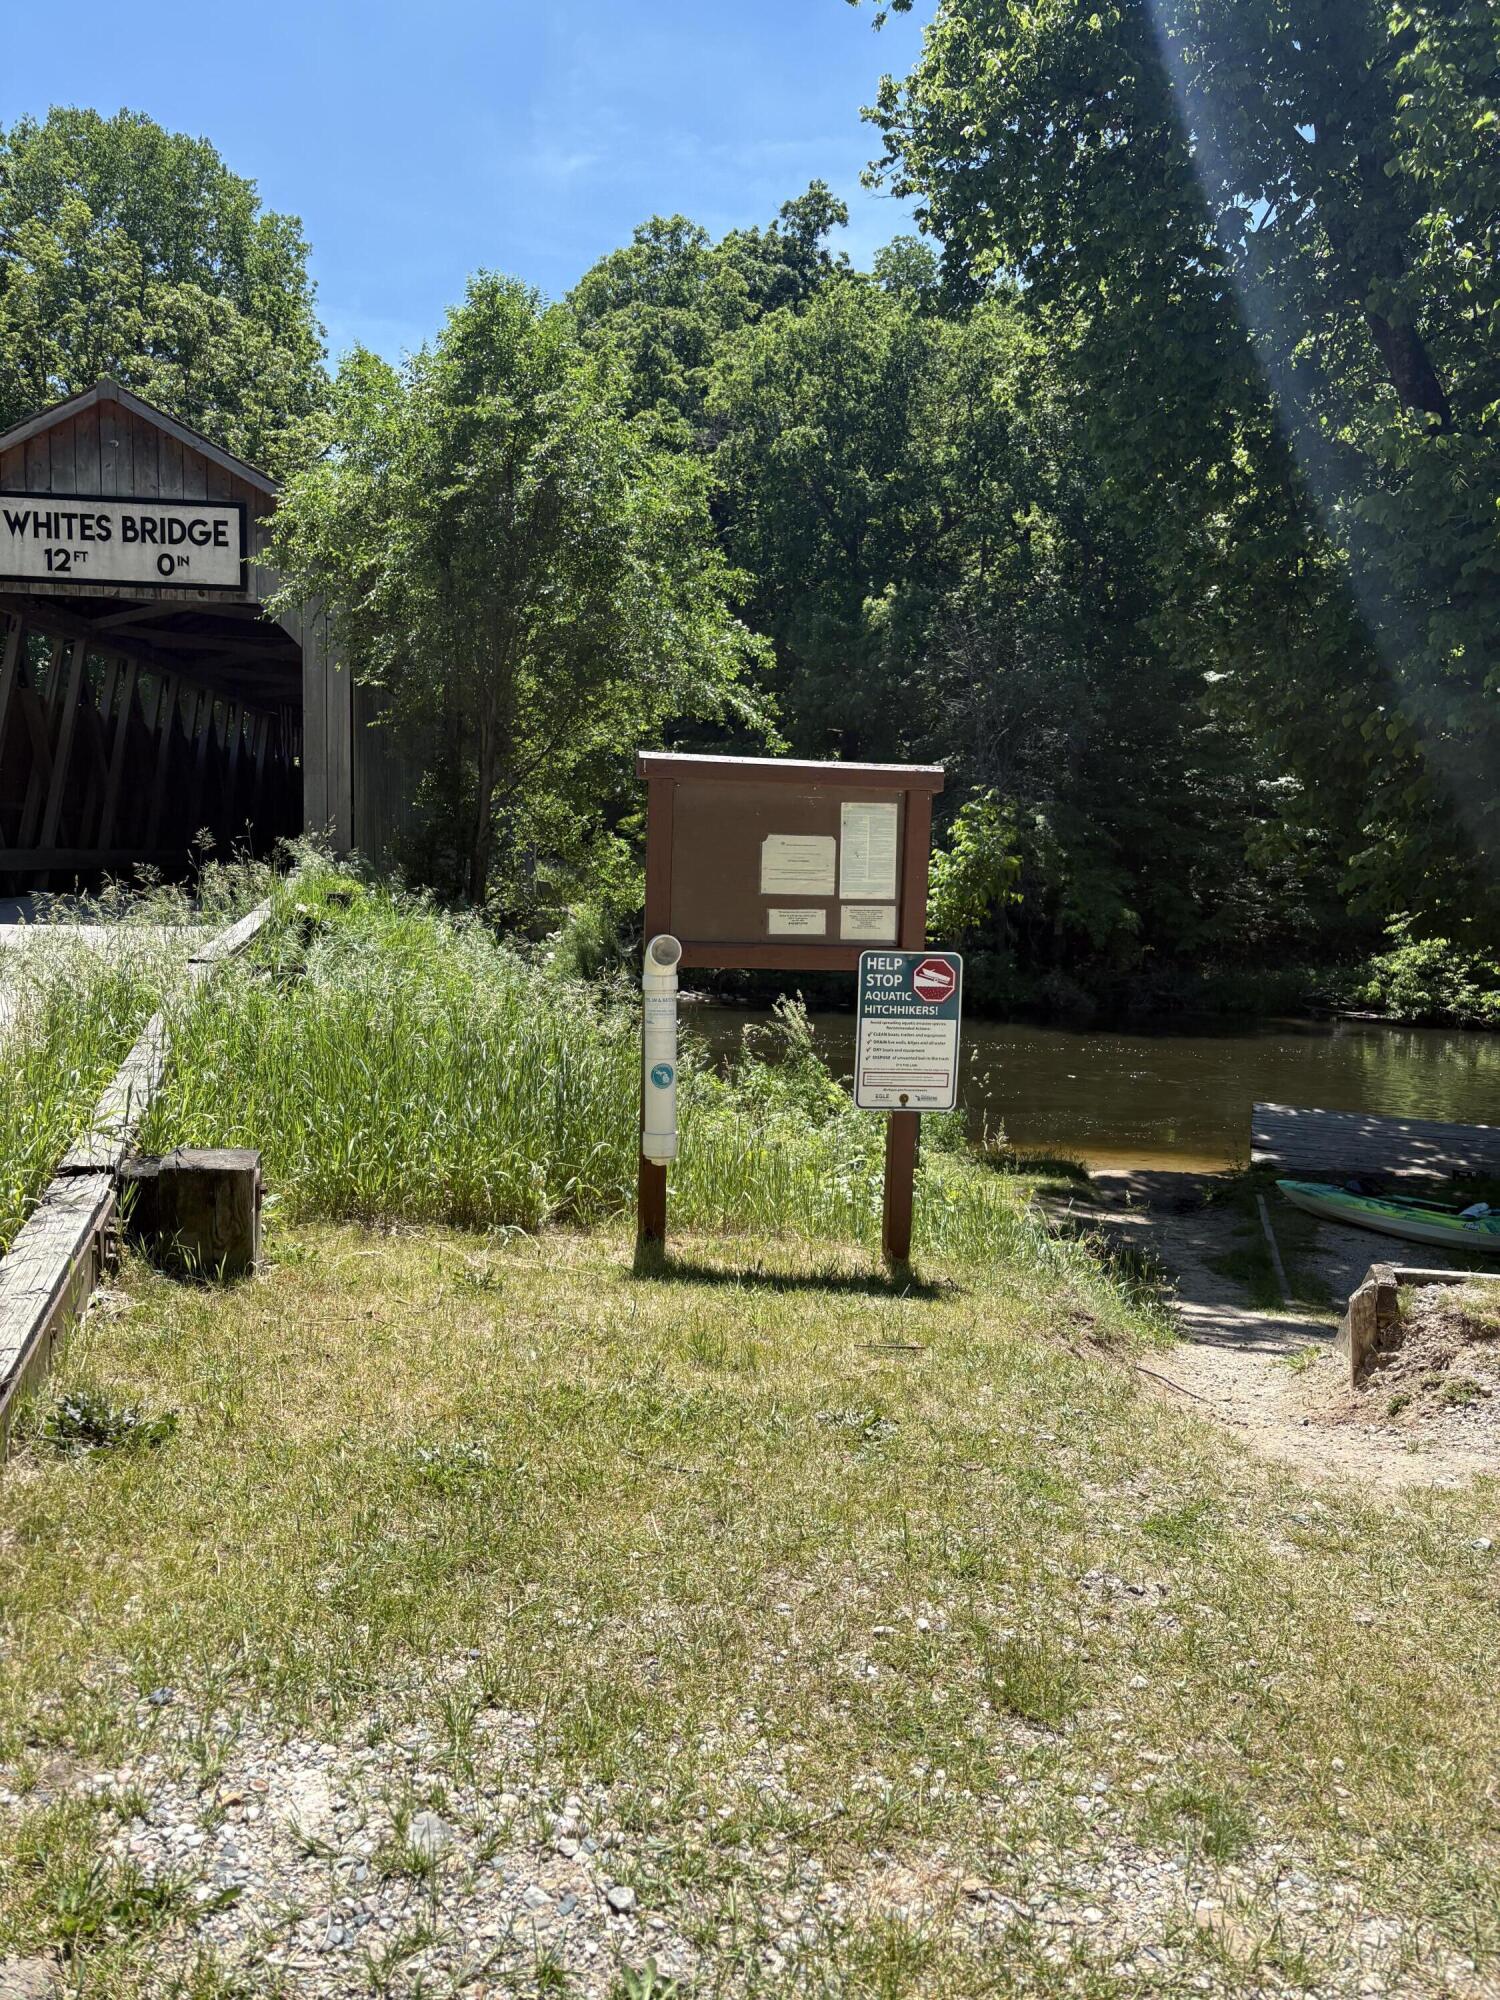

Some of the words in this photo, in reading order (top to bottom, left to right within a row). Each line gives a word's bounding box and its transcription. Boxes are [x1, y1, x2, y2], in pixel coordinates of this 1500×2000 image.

[2, 509, 112, 542] WHITES
[121, 515, 230, 547] BRIDGE
[44, 547, 72, 572] 12
[73, 550, 88, 563] FT
[177, 555, 190, 567] IN
[867, 957, 903, 970] HELP
[866, 974, 903, 987] STOP
[864, 991, 912, 1001] AQUATIC
[864, 1004, 939, 1016] HITCHHIKERS!
